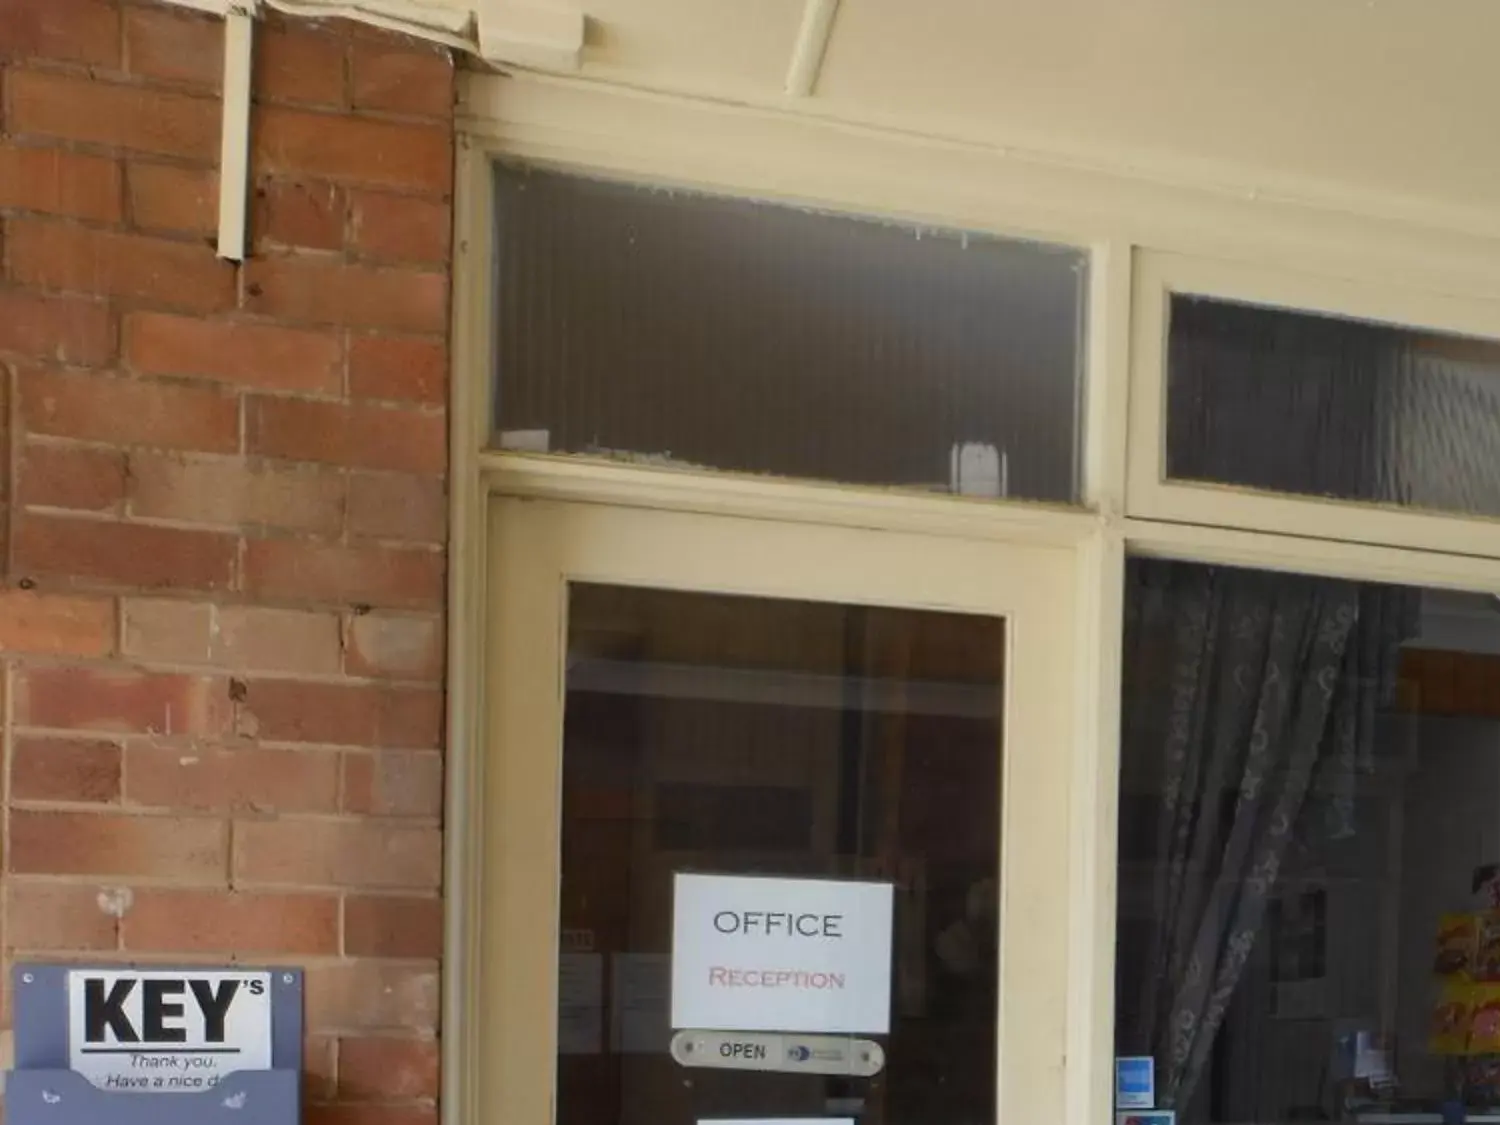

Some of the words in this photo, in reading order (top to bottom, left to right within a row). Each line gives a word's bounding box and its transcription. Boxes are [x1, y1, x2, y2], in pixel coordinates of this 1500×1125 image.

[713, 911, 843, 937] OFFICE
[709, 966, 846, 989] RECEPTION
[719, 1043, 766, 1060] OPEN
[131, 1053, 179, 1068] Thank
[105, 1073, 149, 1087] Have
[153, 1077, 164, 1087] a
[169, 1075, 203, 1087] nice
